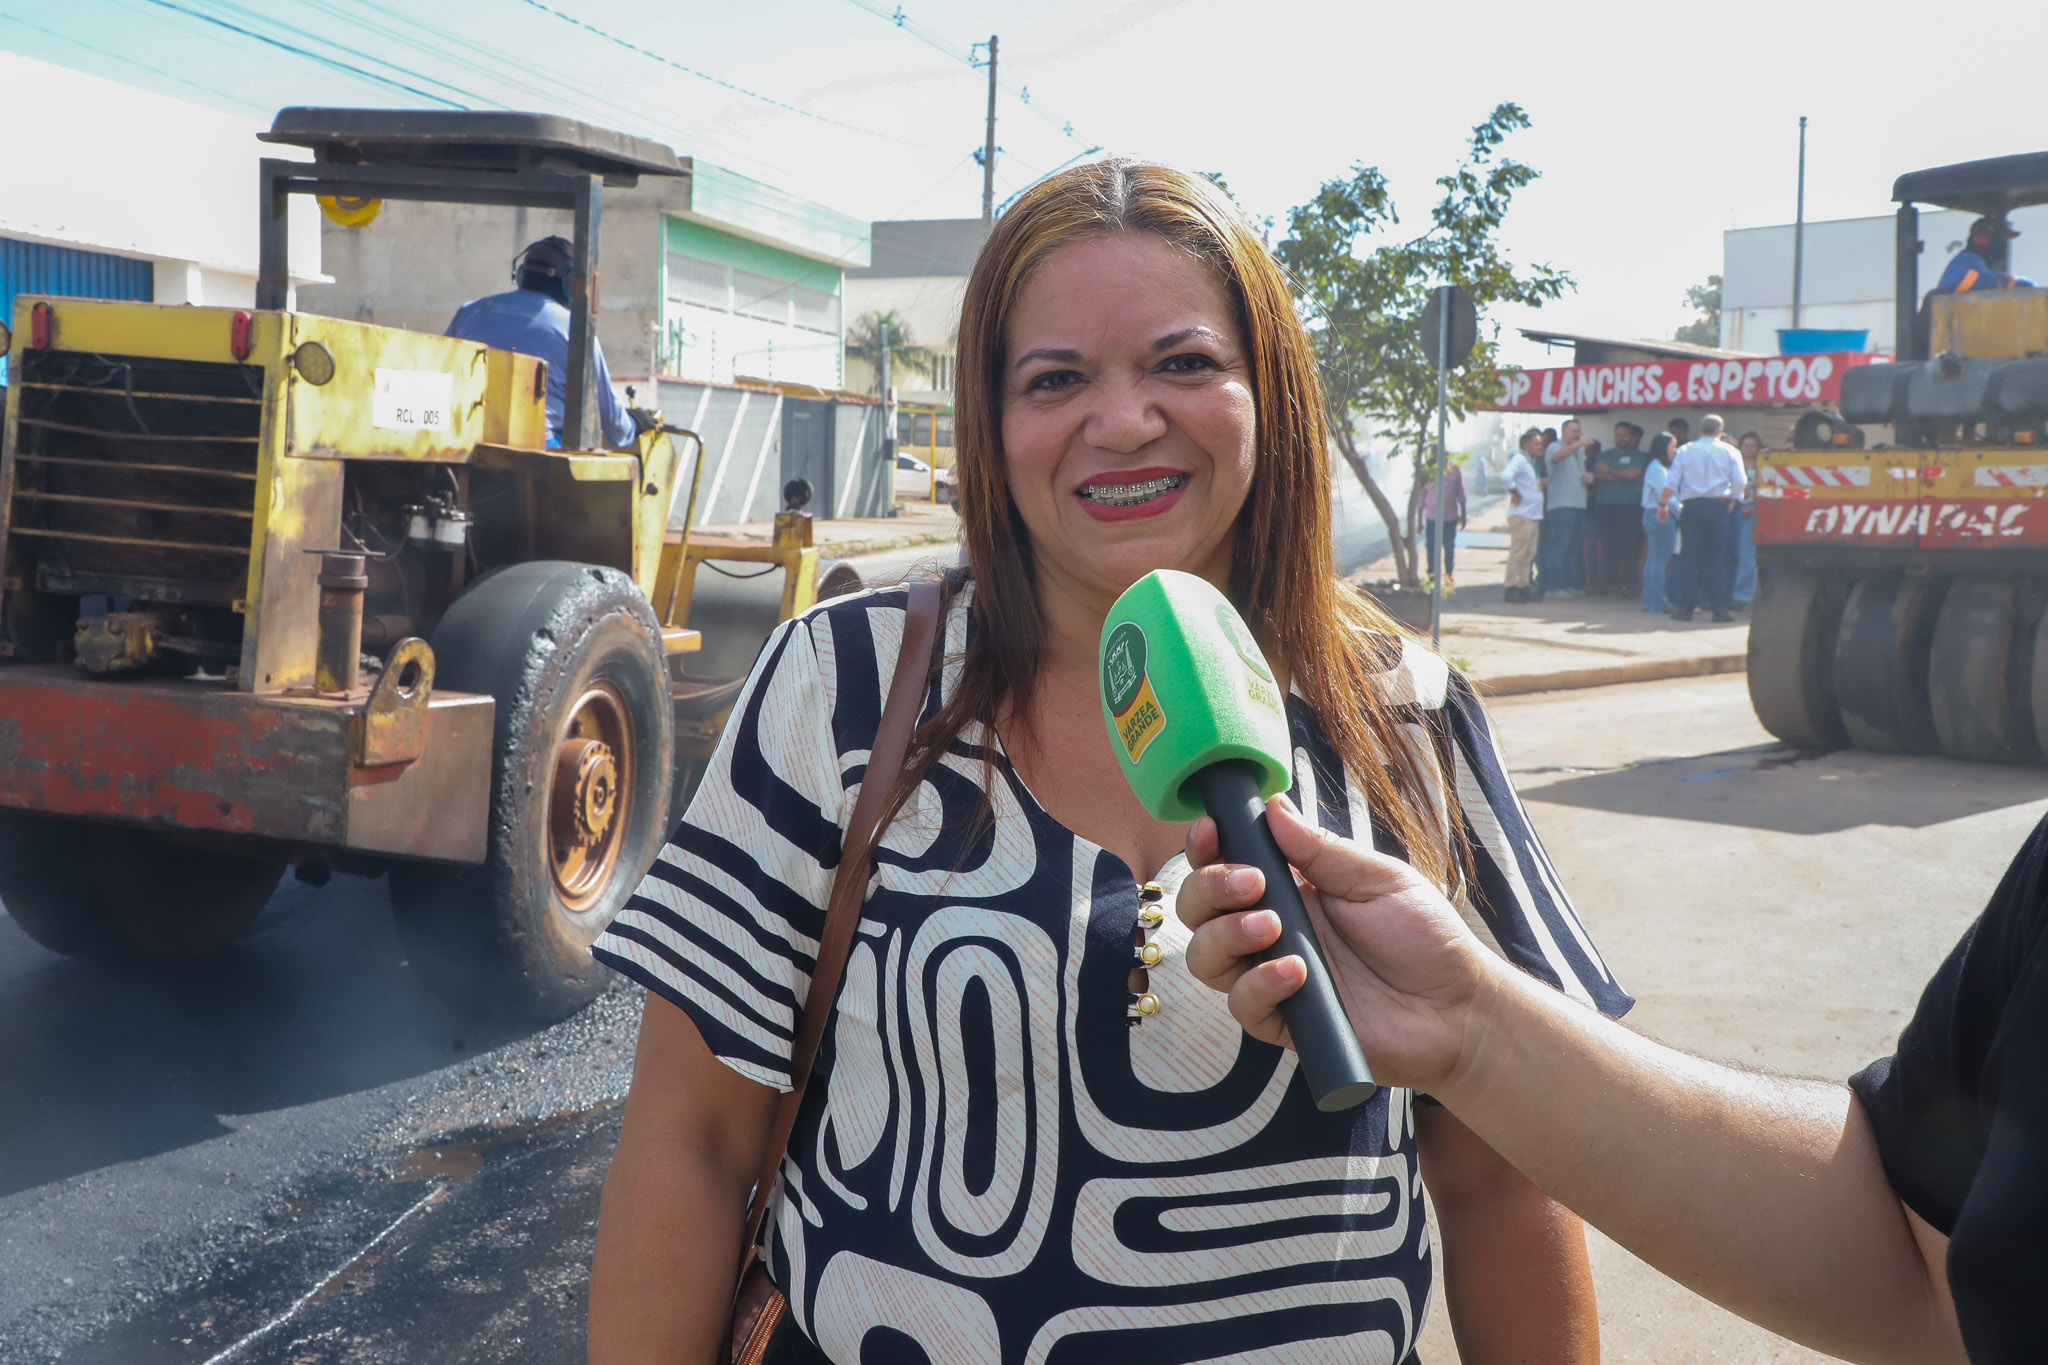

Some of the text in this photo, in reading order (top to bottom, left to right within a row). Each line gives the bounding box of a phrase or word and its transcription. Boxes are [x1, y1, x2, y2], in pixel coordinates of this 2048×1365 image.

[1541, 364, 1664, 406] LANCHES
[1664, 380, 1682, 402] e
[1687, 355, 1834, 402] ESPETOS
[396, 407, 415, 424] RCL
[423, 409, 440, 425] 005
[1804, 503, 2030, 536] DYNAPAC
[1123, 700, 1154, 740] VÁRZEA
[1127, 707, 1160, 752] GRANDE
